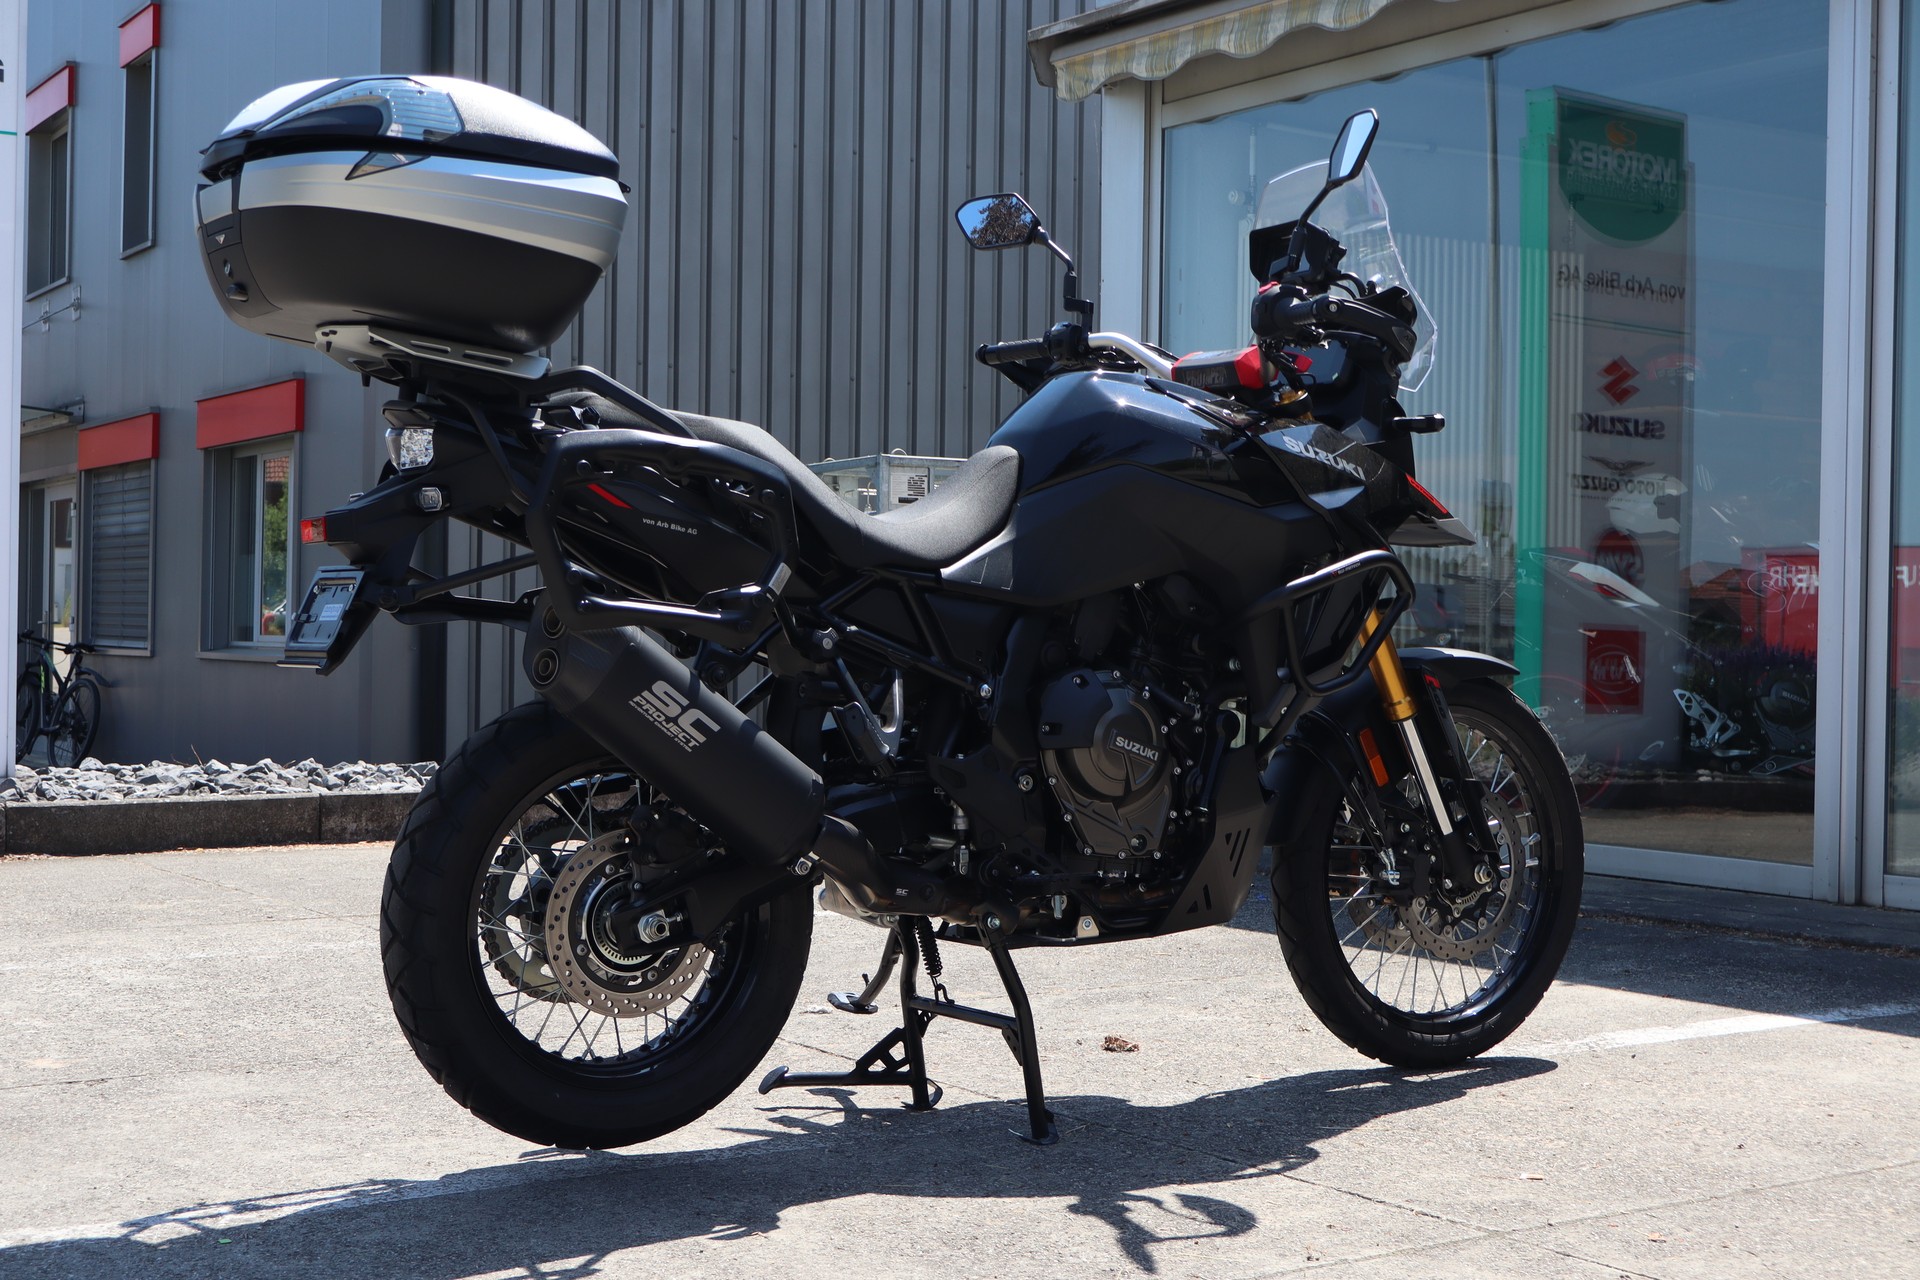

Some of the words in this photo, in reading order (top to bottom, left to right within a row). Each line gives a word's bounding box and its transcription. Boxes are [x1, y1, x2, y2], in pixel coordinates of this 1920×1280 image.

[1282, 435, 1366, 481] SUZUKI
[642, 518, 655, 526] von
[656, 520, 669, 530] Arb
[670, 523, 686, 533] Bike
[632, 695, 699, 747] PROJECT
[641, 680, 721, 744] SC
[674, 737, 693, 753] SYSTEM
[1115, 735, 1159, 762] SUZUKI
